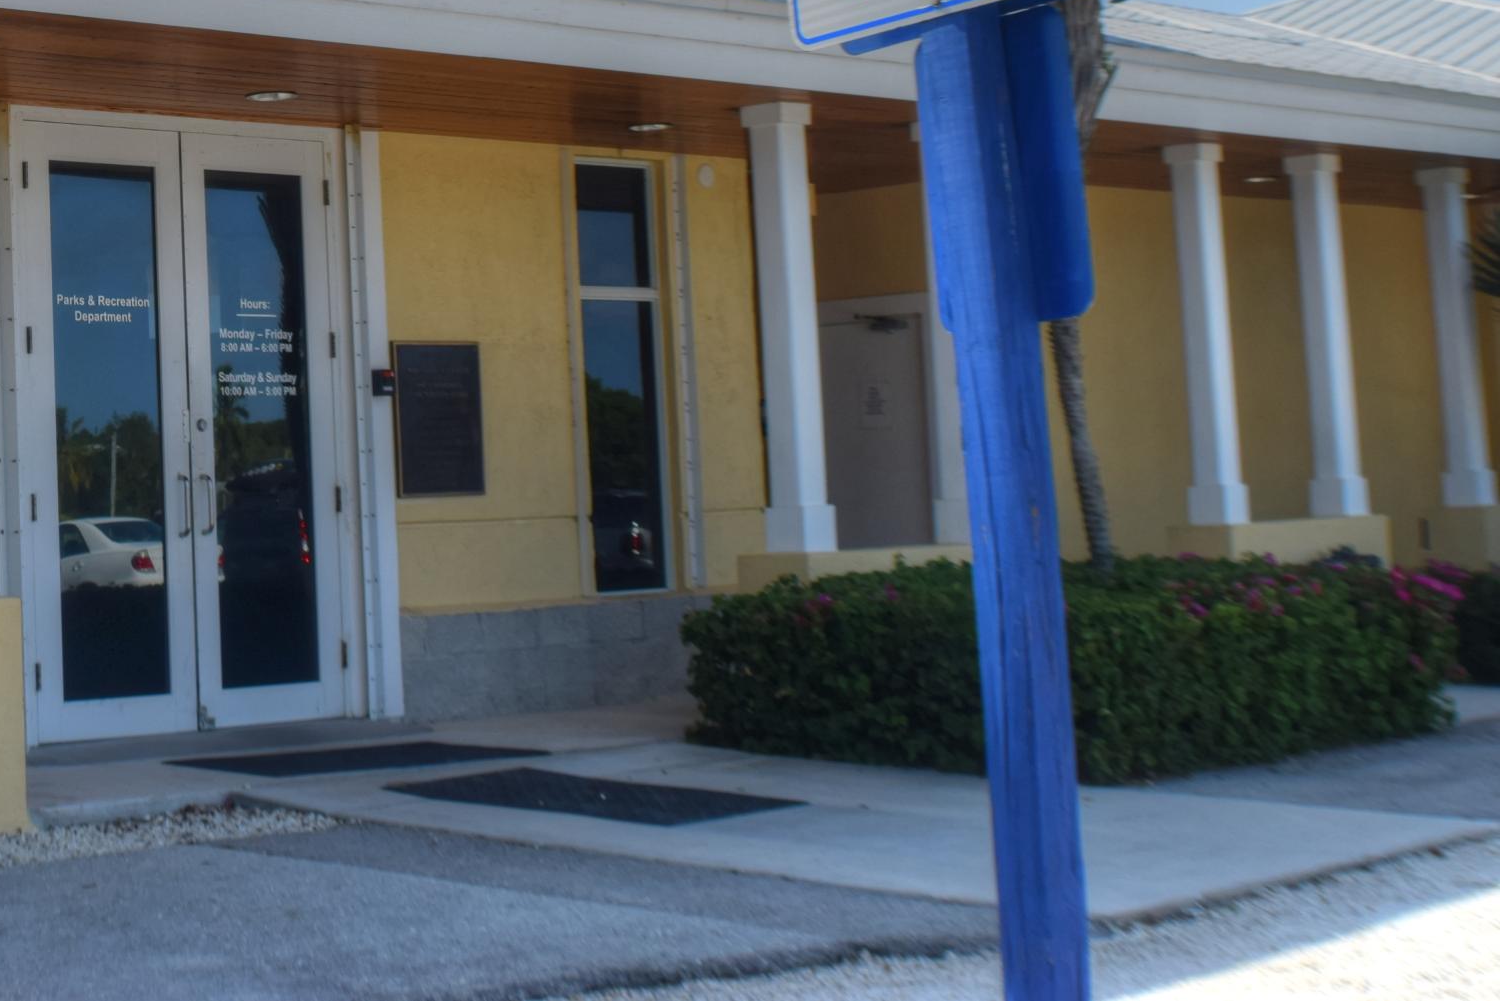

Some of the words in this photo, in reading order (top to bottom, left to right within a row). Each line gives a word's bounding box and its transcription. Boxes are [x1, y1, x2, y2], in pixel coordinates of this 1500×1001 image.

[56, 294, 85, 306] Parks
[87, 294, 96, 306] &
[97, 295, 150, 307] Recreation
[240, 298, 270, 309] Hours:
[74, 310, 132, 324] Department
[219, 328, 255, 342] Monday
[264, 328, 293, 343] Friday
[240, 343, 253, 352] AM
[280, 343, 293, 353] PM
[218, 371, 256, 385] Saturday
[264, 372, 297, 386] Sunday
[243, 386, 257, 396] AM
[283, 386, 297, 396] PM
